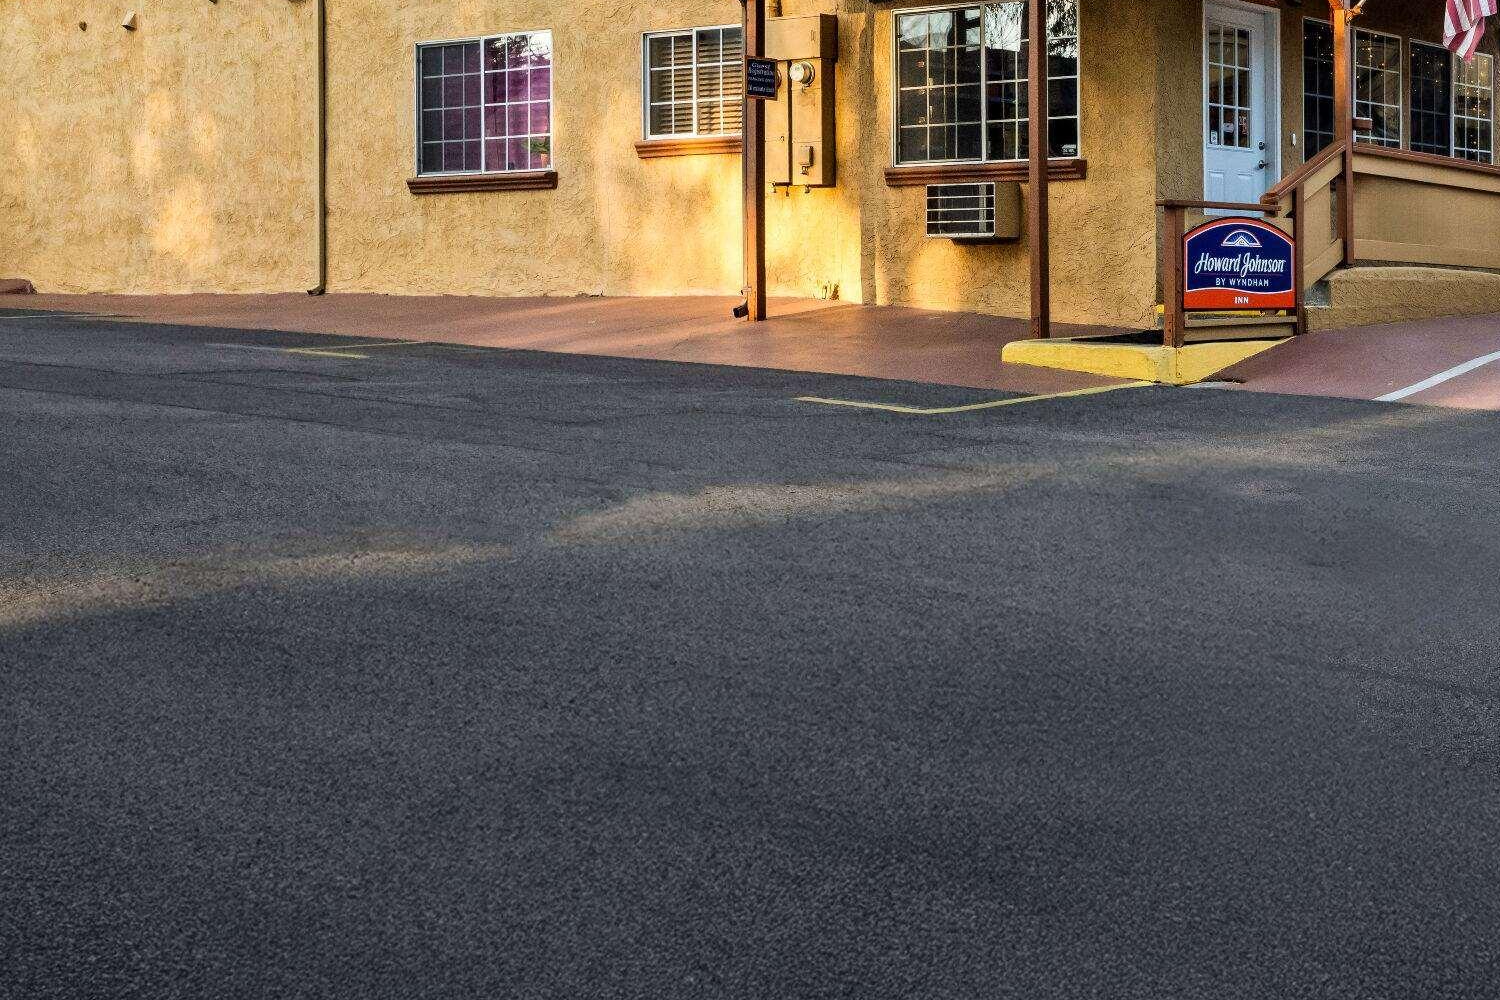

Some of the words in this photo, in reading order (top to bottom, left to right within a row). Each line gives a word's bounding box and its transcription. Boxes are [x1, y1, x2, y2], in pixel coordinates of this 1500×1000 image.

[1194, 252, 1241, 273] Howard
[1240, 252, 1286, 277] Johnson
[1215, 277, 1226, 286] BY
[1229, 278, 1269, 286] WYNDHAM
[1234, 296, 1249, 304] INN
